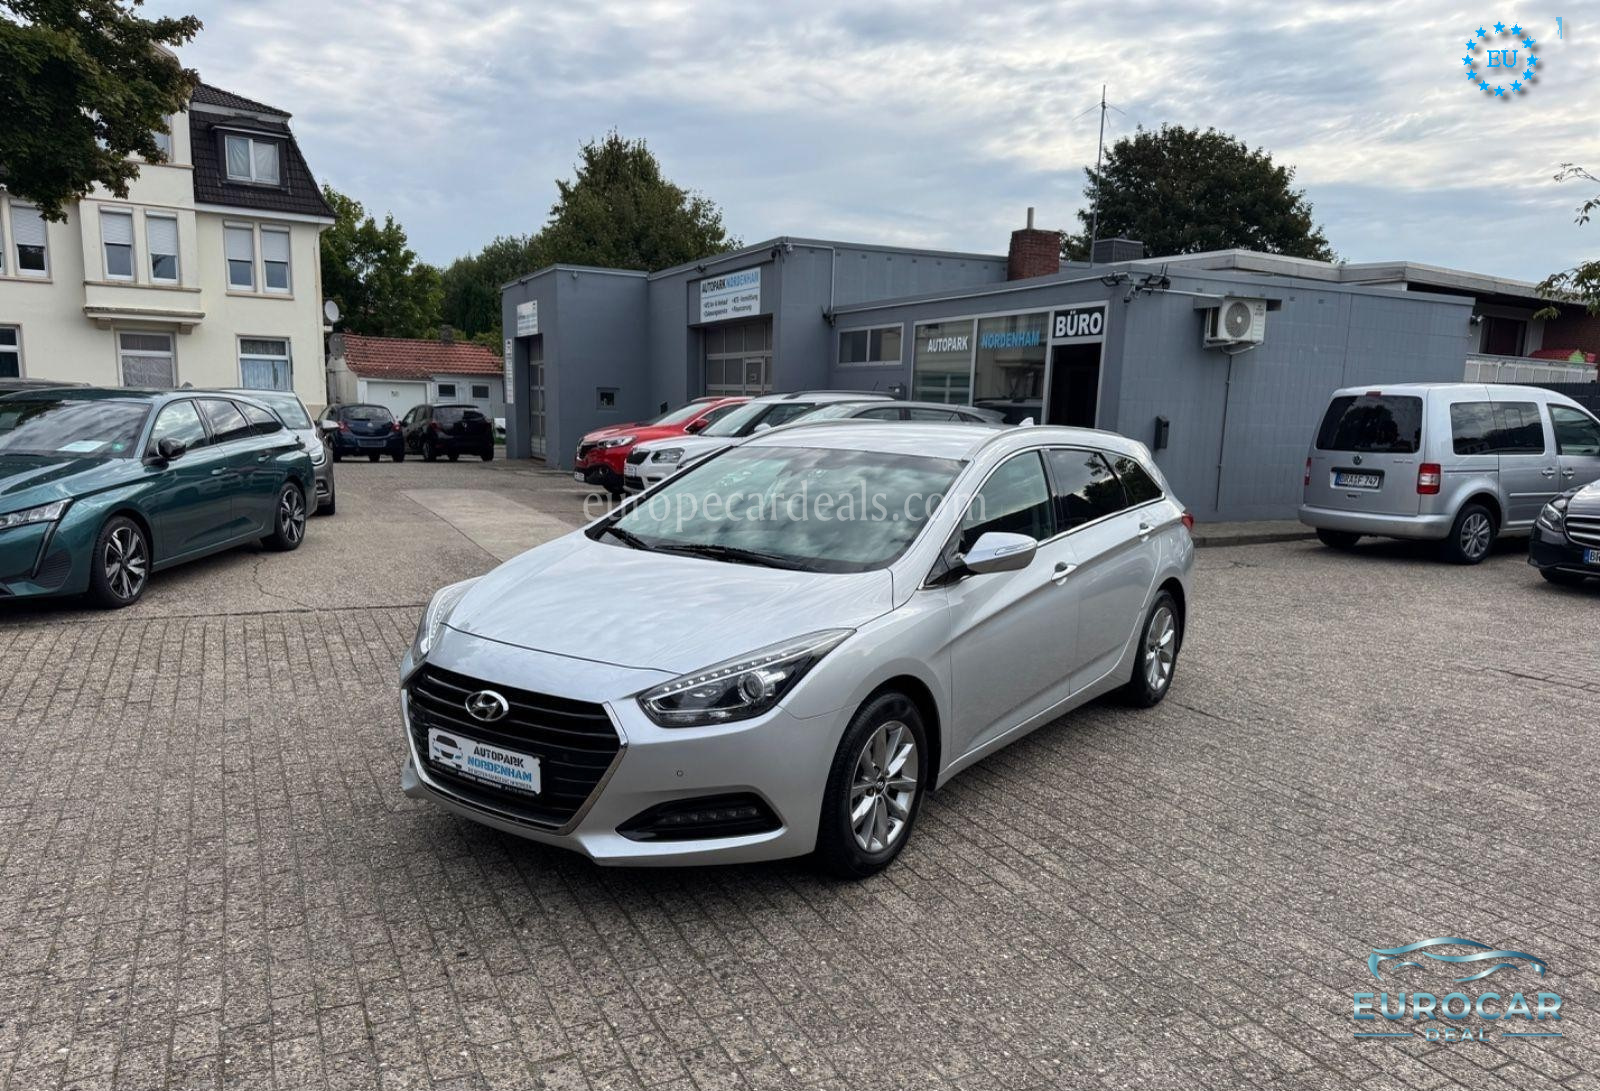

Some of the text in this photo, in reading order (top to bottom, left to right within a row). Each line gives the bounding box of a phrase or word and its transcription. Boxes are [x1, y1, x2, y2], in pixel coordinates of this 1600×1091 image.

[1055, 310, 1102, 337] BÜRO
[927, 329, 1041, 353] AUTOPARK NORDENHAM
[467, 755, 533, 783] NORDENHAM
[473, 745, 524, 769] AUTOPARK
